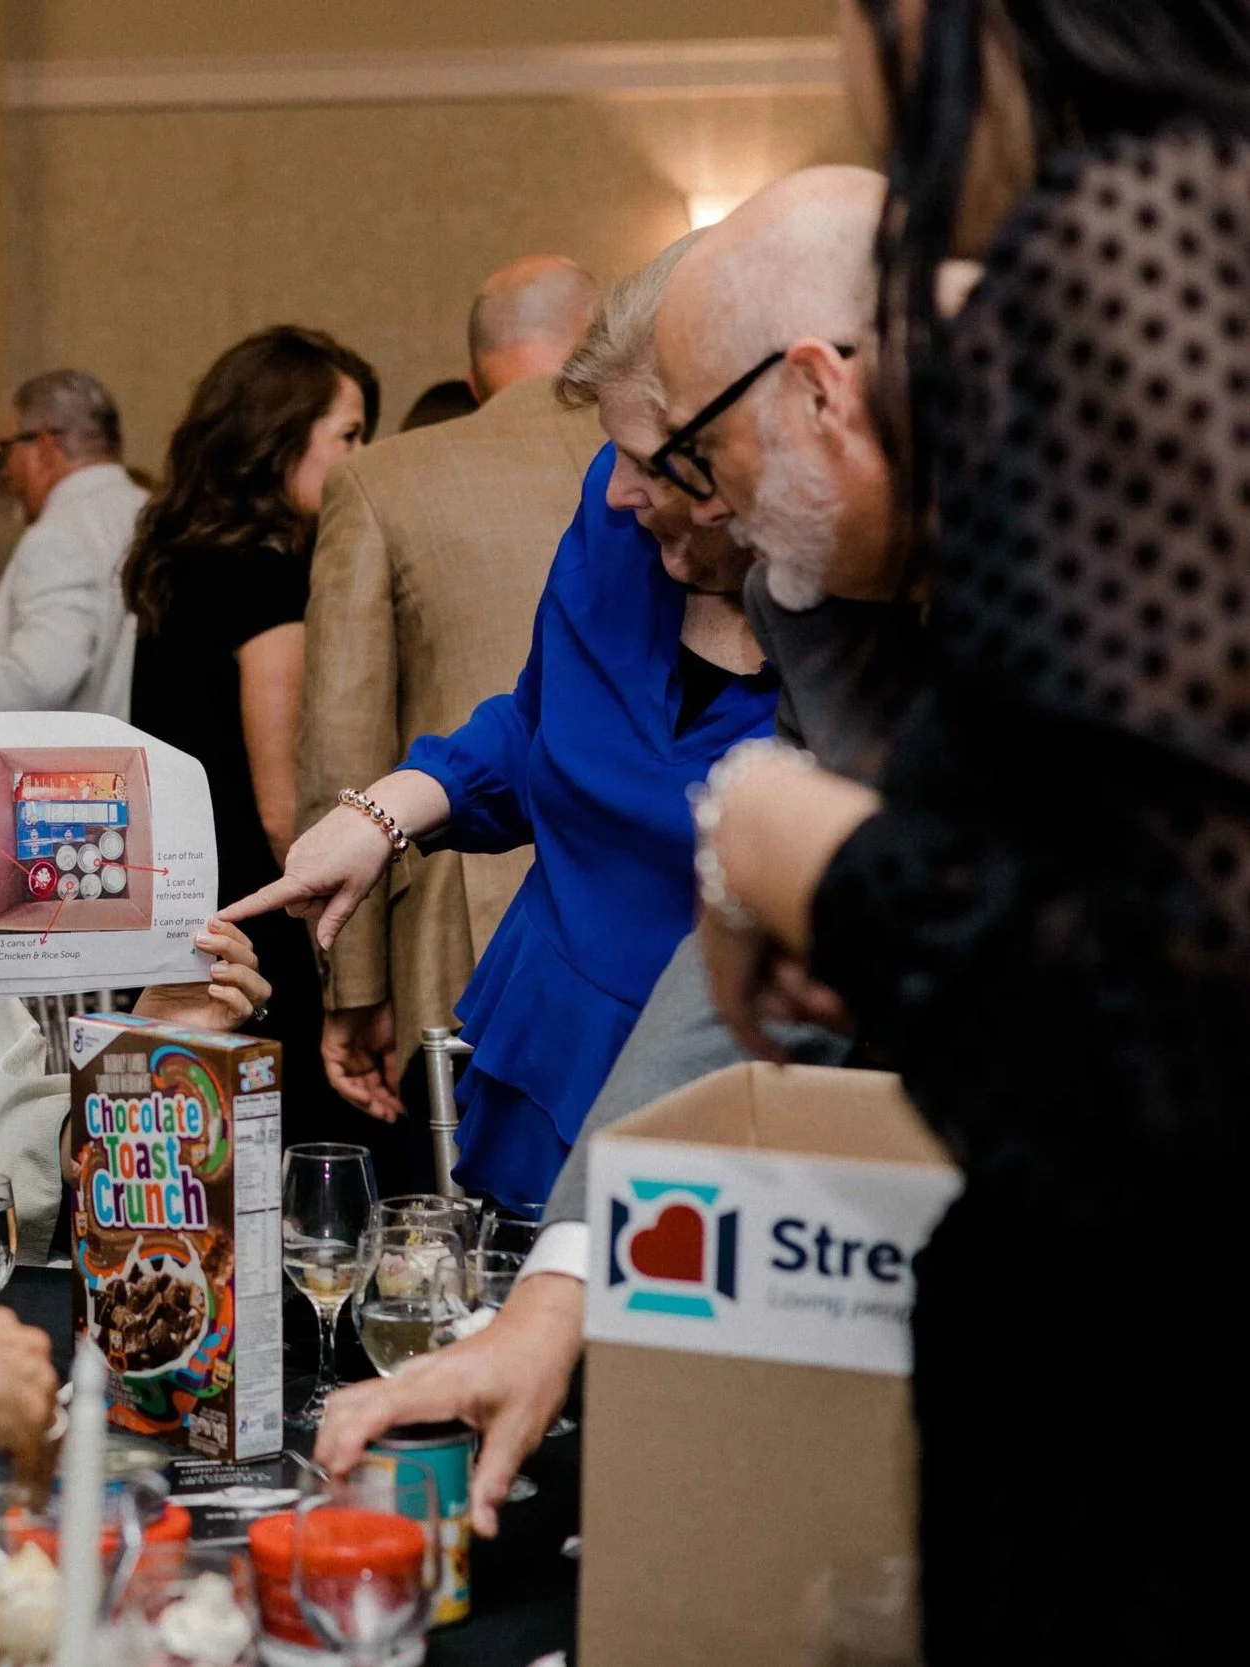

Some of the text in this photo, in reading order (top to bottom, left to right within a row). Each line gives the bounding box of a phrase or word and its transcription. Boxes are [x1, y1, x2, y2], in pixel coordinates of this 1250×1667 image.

[162, 853, 177, 861] can
[178, 851, 187, 860] of
[188, 851, 204, 860] fruit
[172, 879, 186, 887] can
[187, 878, 196, 887] of
[156, 891, 205, 900] refried beans
[159, 919, 174, 927] can
[175, 917, 184, 926] of
[185, 918, 205, 928] pinto
[166, 930, 189, 939] beans
[6, 940, 26, 948] cans
[27, 939, 36, 947] of
[33, 951, 40, 960] &
[41, 951, 59, 959] Rice
[60, 950, 81, 960] Soup
[86, 1095, 200, 1135] Chocolate
[104, 1134, 181, 1181] Toast
[93, 1169, 205, 1226] Crunch
